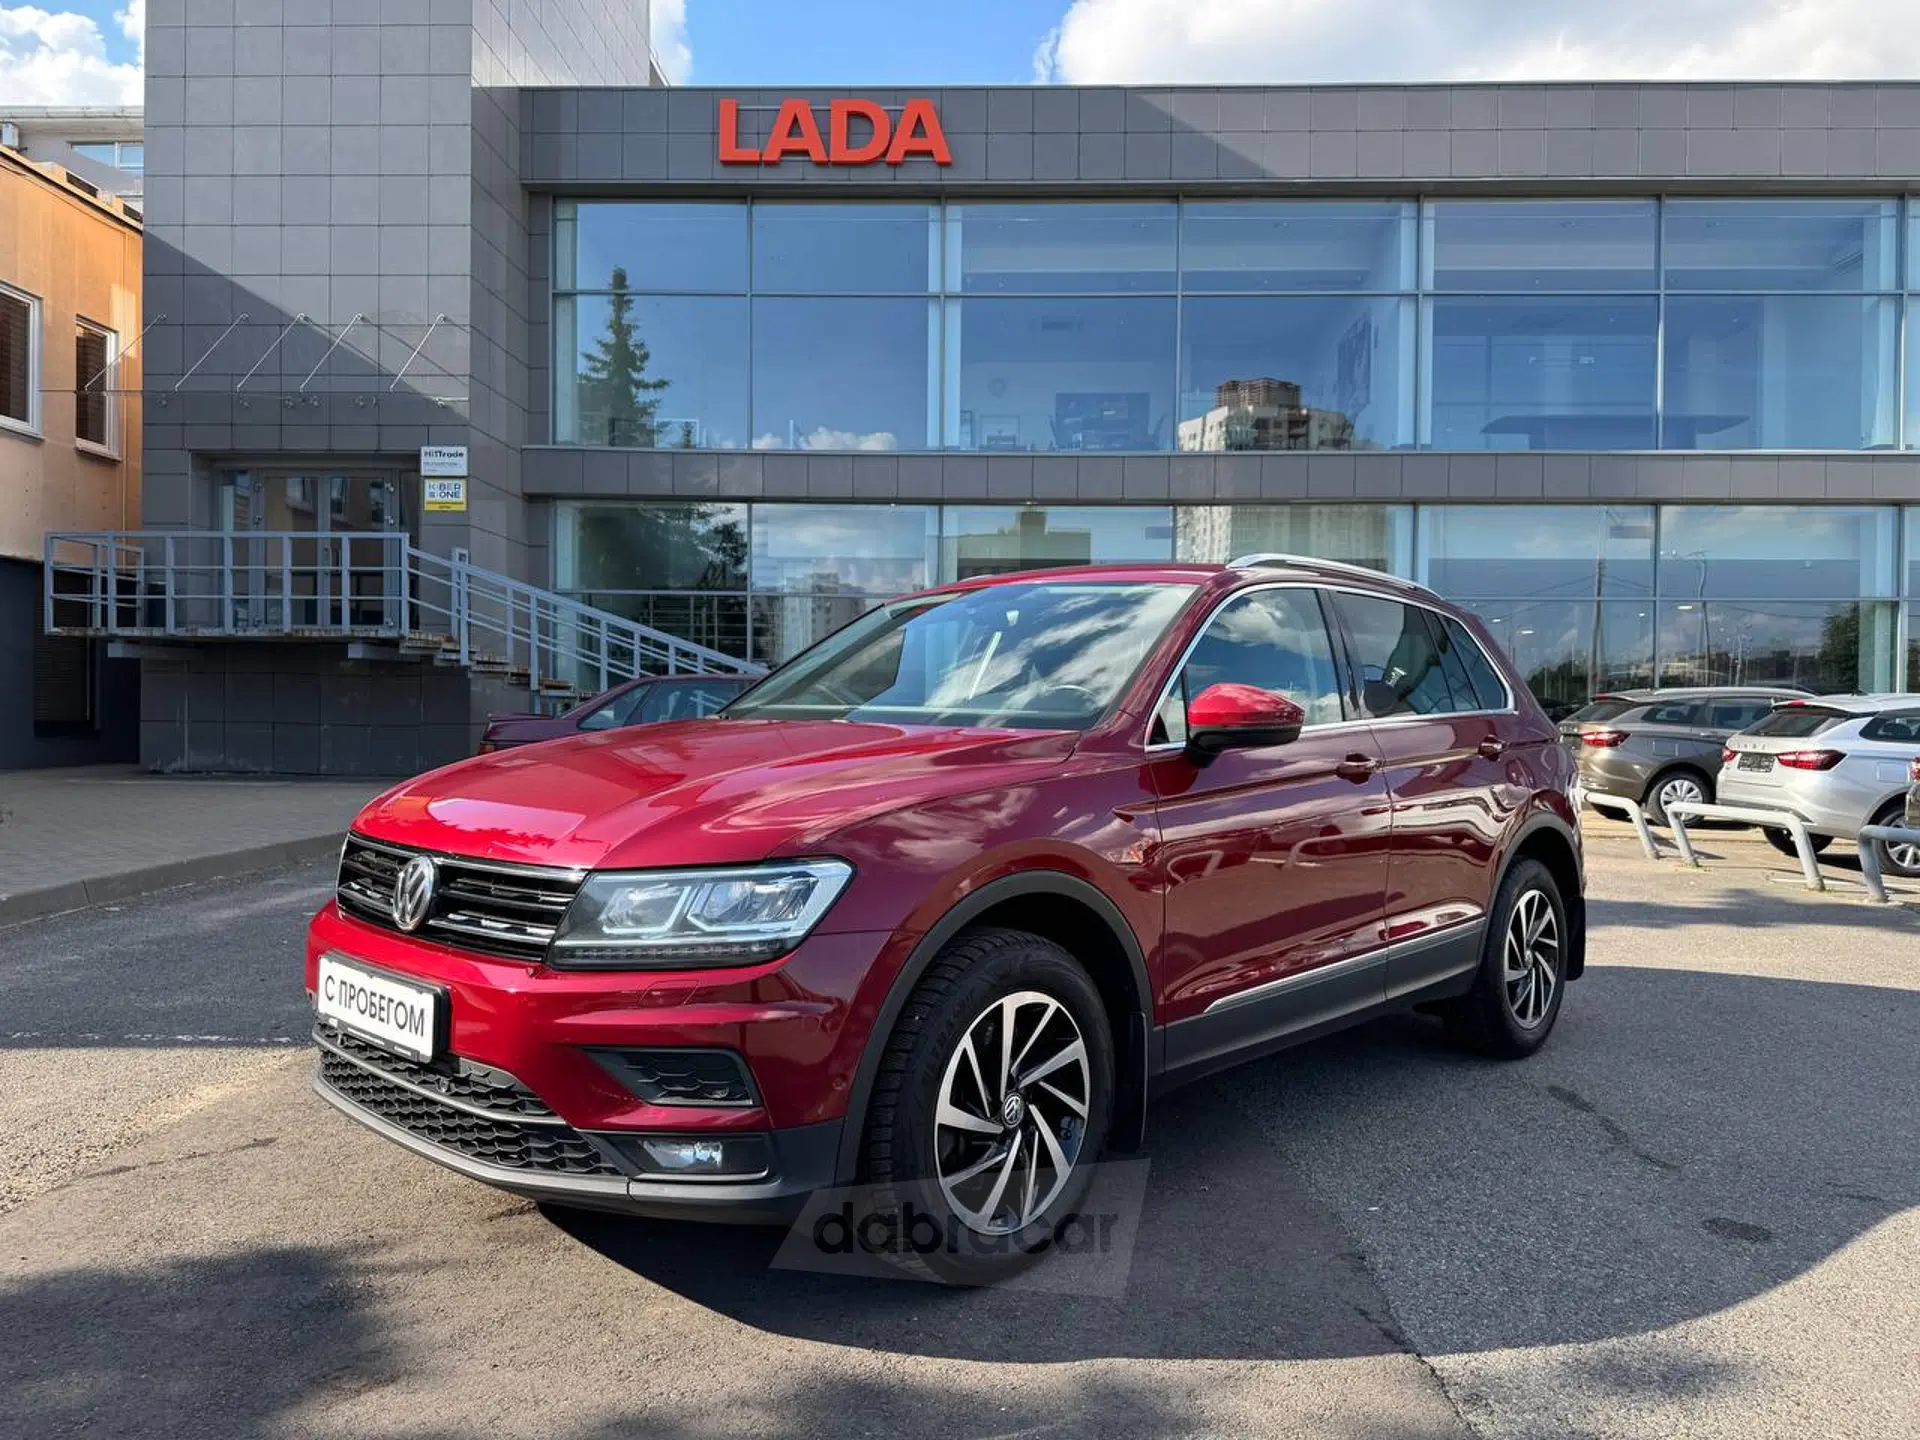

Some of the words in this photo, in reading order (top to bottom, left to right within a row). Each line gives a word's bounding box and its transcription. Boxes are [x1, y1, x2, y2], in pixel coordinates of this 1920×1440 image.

[719, 98, 953, 165] LADA
[324, 974, 336, 1002] С
[338, 979, 426, 1038] ПРОБЕГОМ
